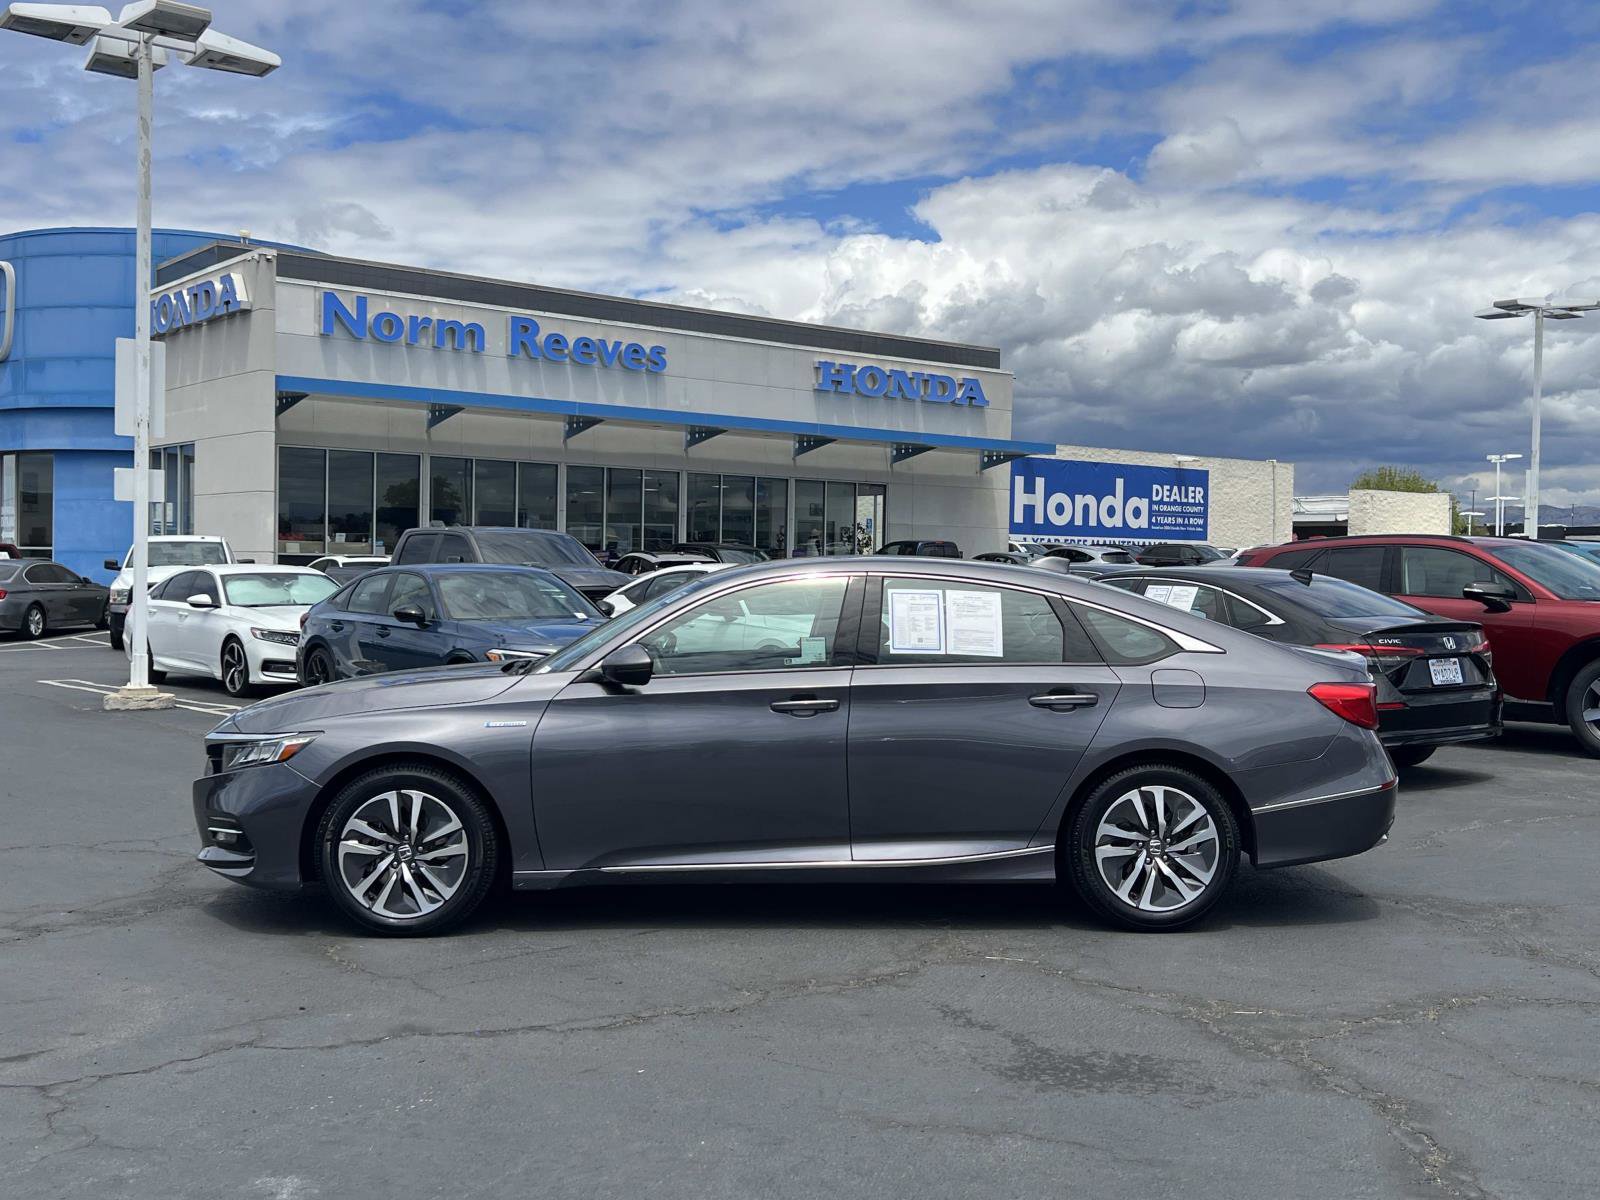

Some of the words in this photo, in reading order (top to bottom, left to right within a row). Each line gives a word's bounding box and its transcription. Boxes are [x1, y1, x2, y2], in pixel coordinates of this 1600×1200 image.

[150, 273, 241, 337] ONDA
[321, 291, 485, 352] Norm
[508, 316, 667, 373] Reeves
[815, 361, 989, 407] HONDA
[1014, 475, 1149, 529] Honda
[1151, 504, 1159, 512] IN
[1160, 504, 1182, 512] ORANGE
[1182, 505, 1204, 513] COUNTY
[1152, 484, 1204, 503] DEALER
[1151, 516, 1156, 524] 4
[1156, 516, 1176, 524] YEARS
[1176, 517, 1183, 525] IN
[1184, 517, 1189, 525] A
[1190, 517, 1204, 525] ROW
